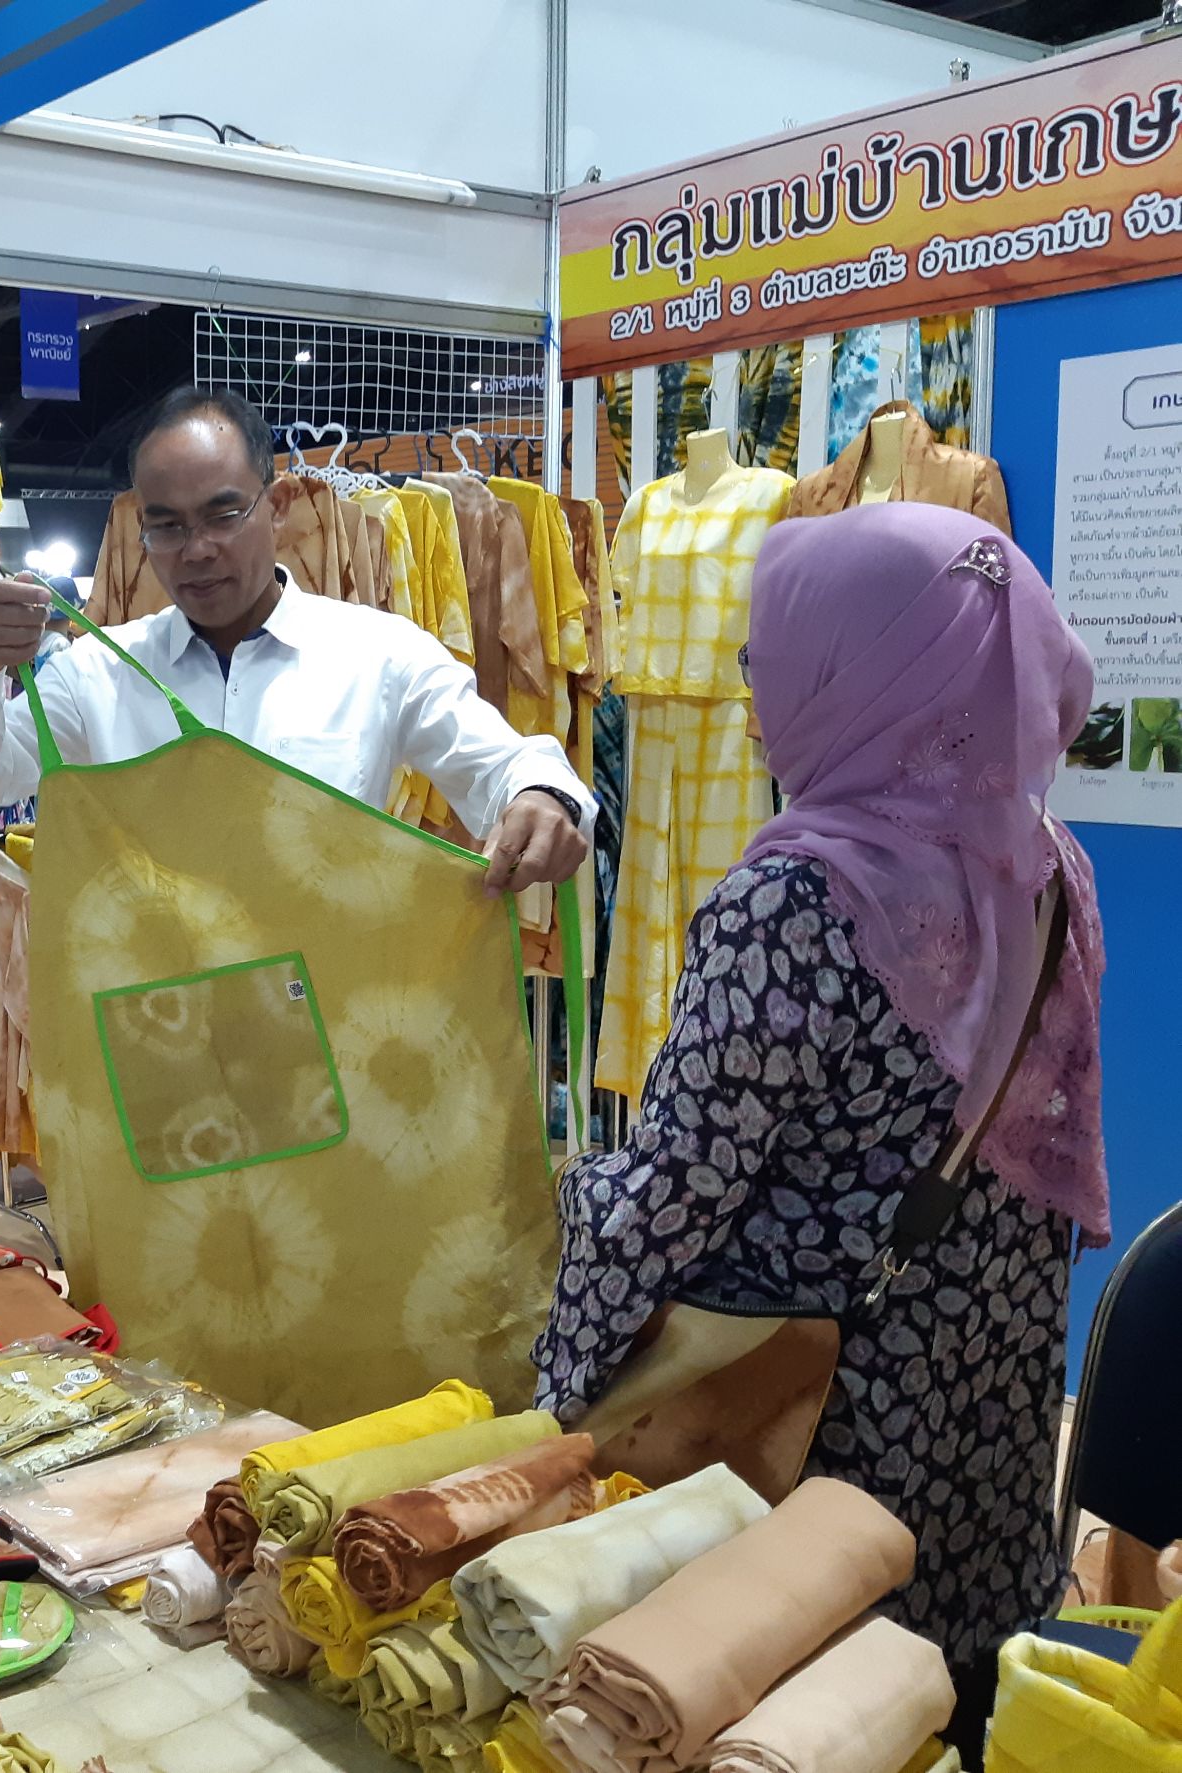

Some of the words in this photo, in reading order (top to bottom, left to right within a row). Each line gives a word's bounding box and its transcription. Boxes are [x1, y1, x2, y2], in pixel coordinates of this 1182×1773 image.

[612, 307, 653, 338] 2/1
[667, 280, 720, 328] หมู่ที่
[732, 288, 750, 313] 3
[763, 250, 904, 306] ตำบลยะต๊ะ
[921, 212, 1107, 275] อำเภอรามัน
[27, 331, 74, 346] กระทรวง
[30, 346, 72, 361] พาณิชย์
[1152, 635, 1158, 645] 1
